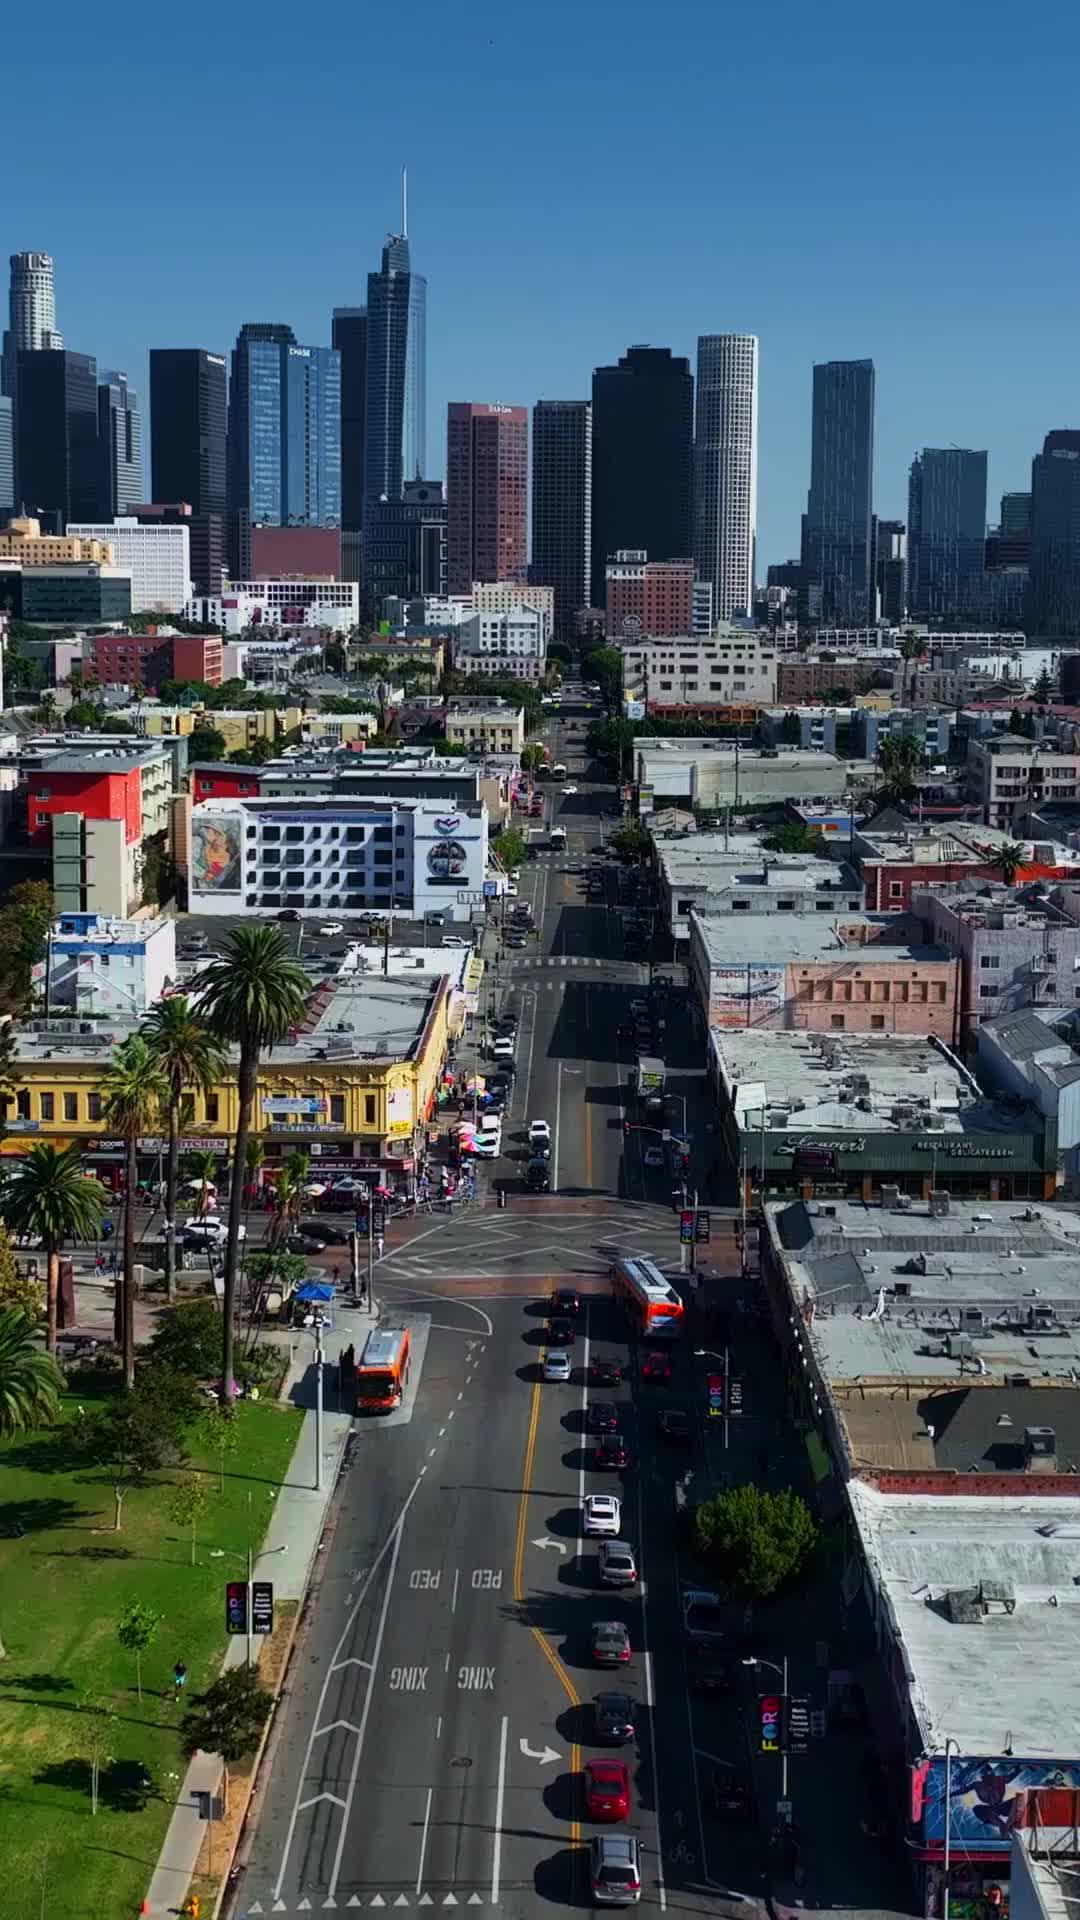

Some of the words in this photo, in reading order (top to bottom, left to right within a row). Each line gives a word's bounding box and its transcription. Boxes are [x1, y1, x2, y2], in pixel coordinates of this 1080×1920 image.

[177, 1140, 225, 1148] ITCHEN
[409, 1569, 440, 1589] PED
[471, 1569, 503, 1589] PED
[389, 1666, 429, 1690] XING
[457, 1666, 496, 1690] XING
